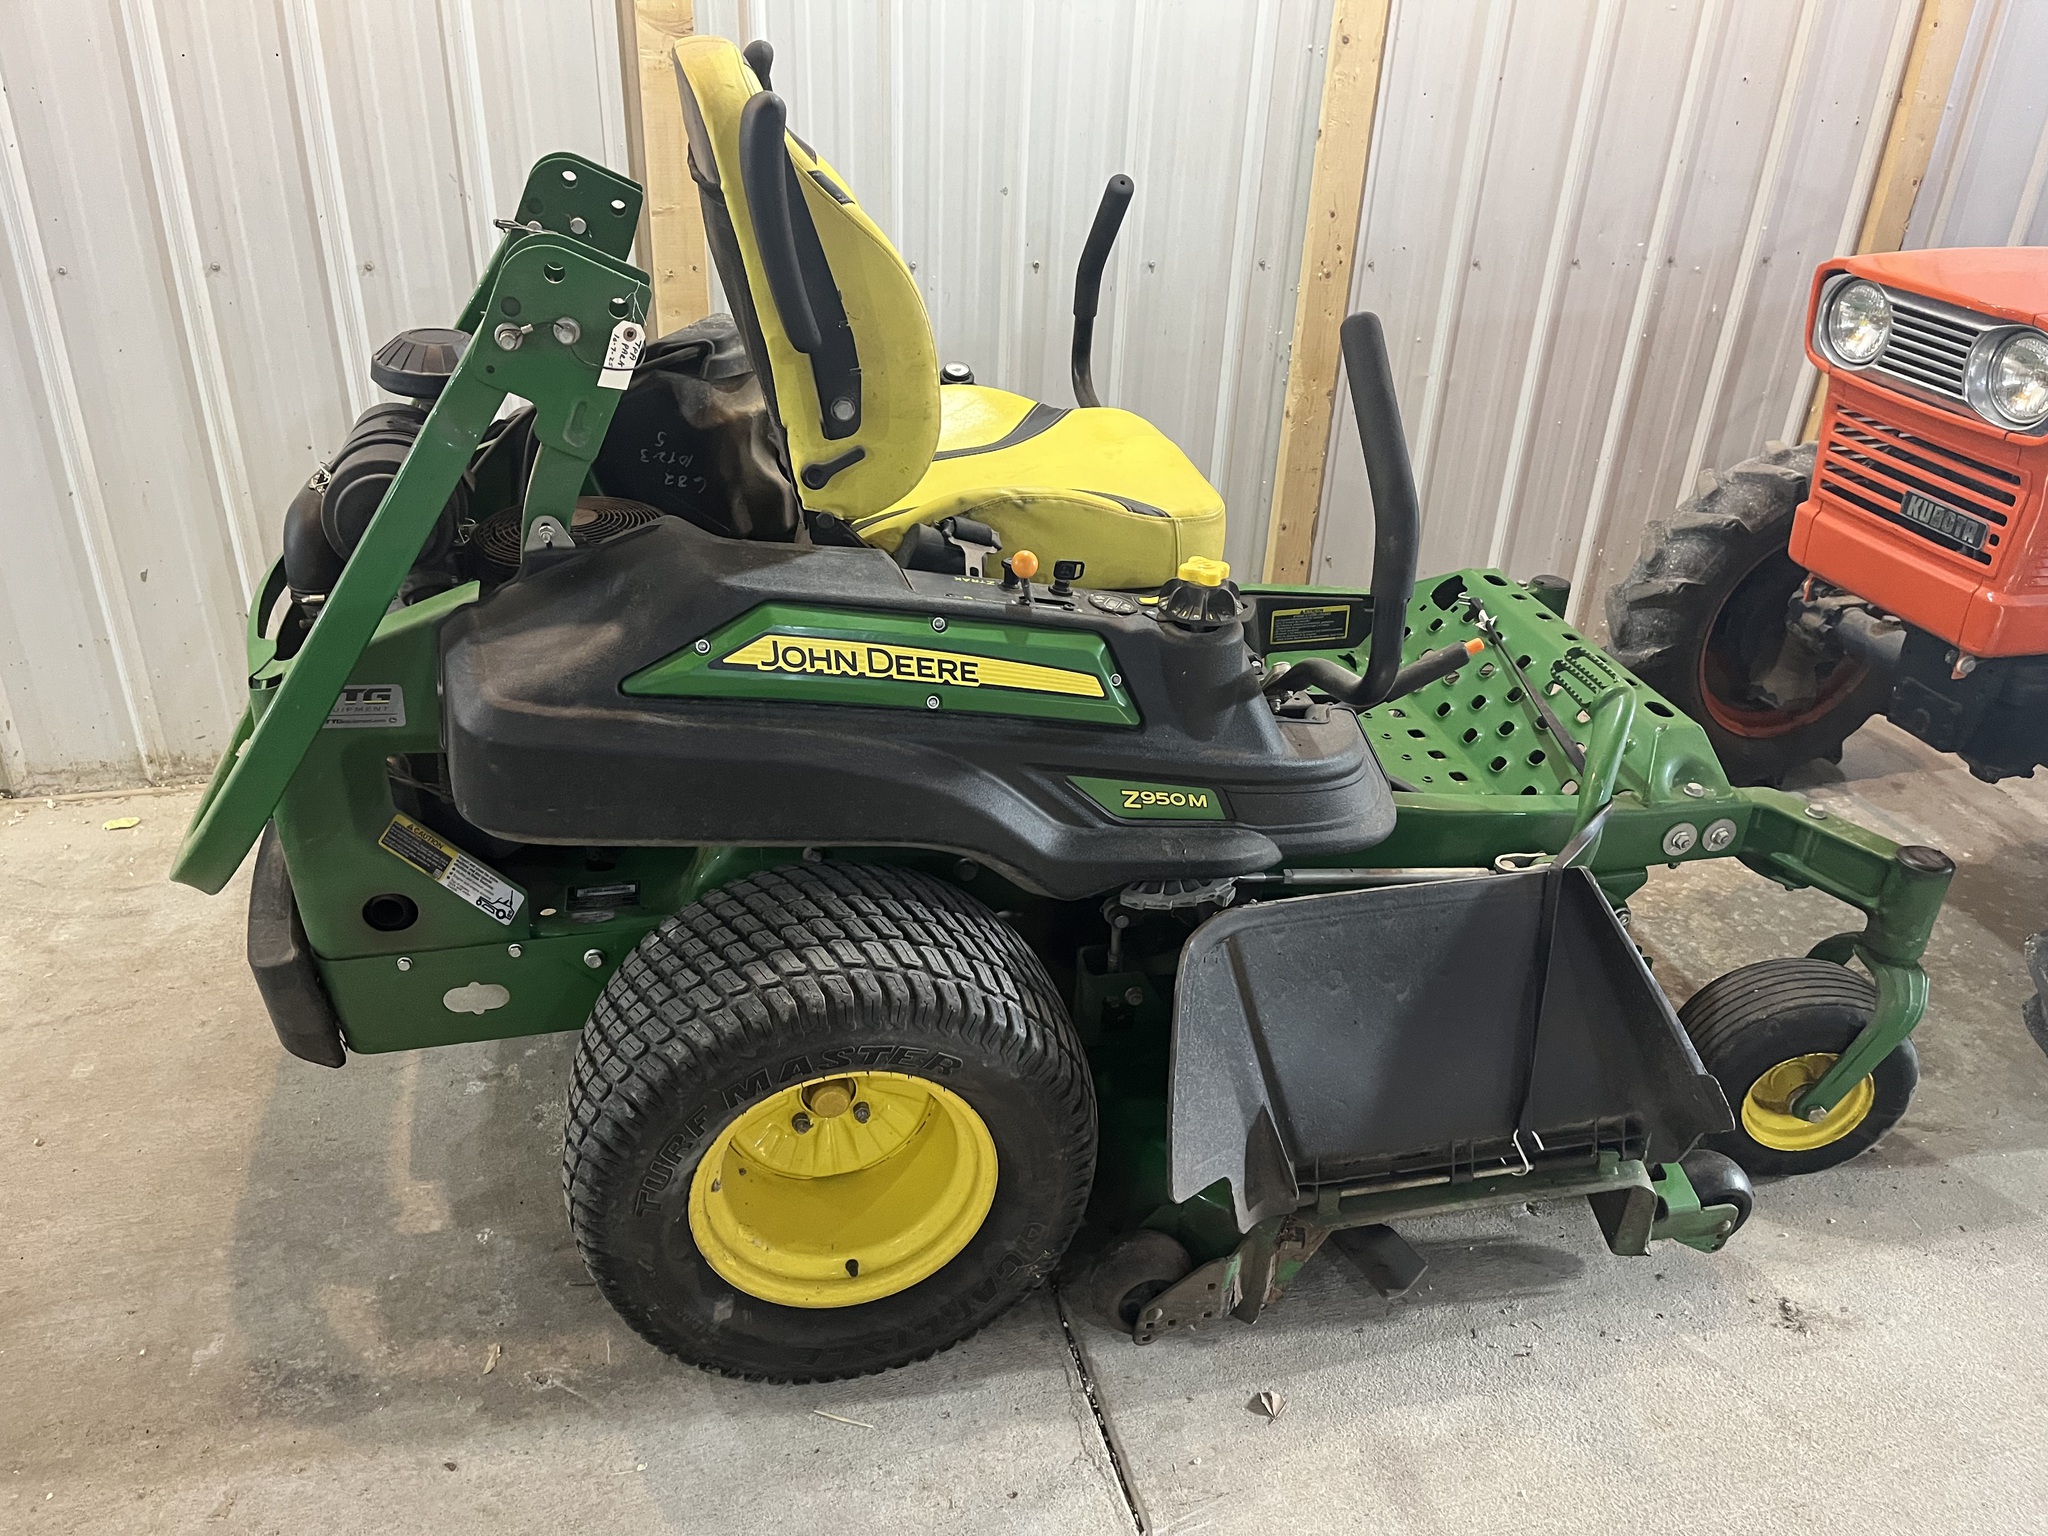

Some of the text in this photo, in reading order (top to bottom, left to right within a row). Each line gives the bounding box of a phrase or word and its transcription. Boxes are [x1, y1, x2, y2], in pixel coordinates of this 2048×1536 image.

[1906, 495, 1980, 544] KUBOTA
[761, 640, 979, 683] JOHN DEERE
[342, 688, 392, 704] TG
[1121, 789, 1209, 809] Z950M
[413, 827, 444, 850] CAUTION
[632, 1045, 964, 1217] TURF MASTER
